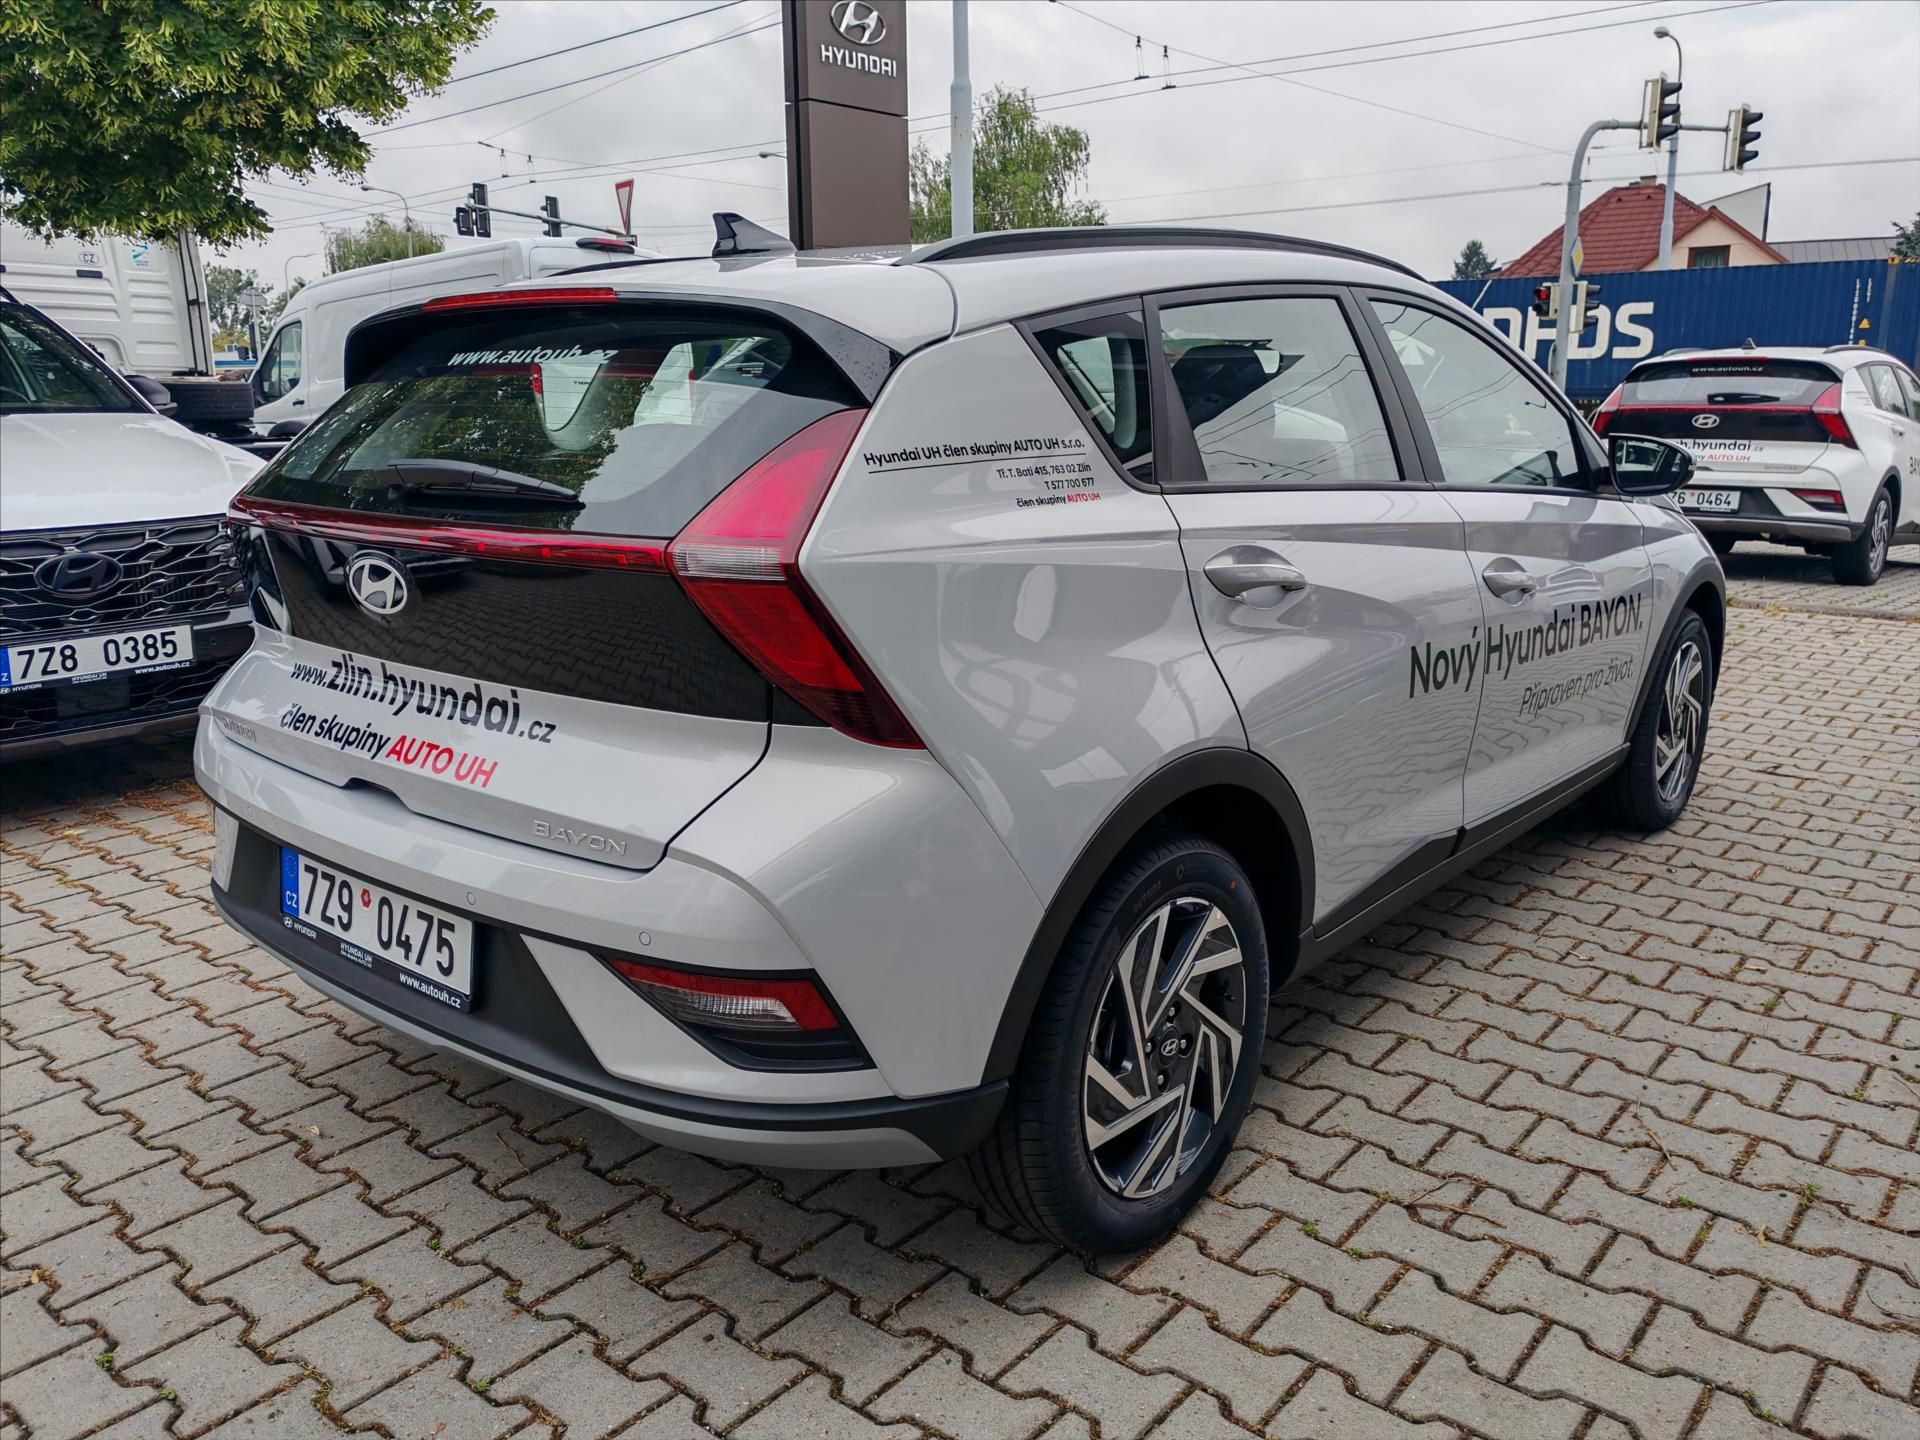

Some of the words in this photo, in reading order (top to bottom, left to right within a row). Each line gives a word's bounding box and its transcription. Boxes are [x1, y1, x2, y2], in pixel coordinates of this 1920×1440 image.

[821, 44, 897, 77] HYUNDAI
[448, 345, 619, 366] www.autouhcz
[863, 448, 921, 466] Hyundai
[921, 446, 943, 460] UH
[943, 444, 969, 458] člen
[970, 440, 1012, 456] skupiny
[1014, 438, 1043, 451] AUTO
[1043, 438, 1061, 450] UH
[1061, 438, 1085, 449] s.r.o.
[1676, 439, 1764, 452] h.hyundai.cz
[1707, 453, 1734, 461] AUTO
[1066, 464, 1077, 473] 02
[1052, 479, 1065, 489] 577
[1065, 479, 1081, 488] 700
[1081, 477, 1094, 487] 677
[1016, 497, 1036, 508] člen
[1036, 494, 1067, 506] skupiny
[1067, 493, 1088, 503] AUTO
[1088, 492, 1101, 501] UH
[1696, 492, 1731, 507] 0464
[17, 644, 79, 680] 7Z8
[103, 630, 178, 667] 0385
[1409, 626, 1481, 698] Nový
[1485, 608, 1576, 680] Hyundai
[1579, 592, 1643, 646] BAYON.
[134, 661, 190, 675] www.autouh.cz
[12, 683, 42, 692] HYUNDAI
[1519, 681, 1582, 718] Připraven
[1581, 668, 1604, 700] pro
[291, 653, 556, 744] www.zlin.hyundai.cz
[280, 702, 315, 735] člen
[314, 714, 391, 760] skupiny
[385, 735, 455, 776] AUTO
[454, 753, 498, 789] UH
[533, 819, 627, 857] BAYON
[285, 890, 298, 908] CZ
[304, 863, 353, 933] 7Z9
[377, 896, 456, 977] 0475
[293, 922, 317, 940] HYUNDAI
[400, 973, 461, 1009] www.autouh.cz
